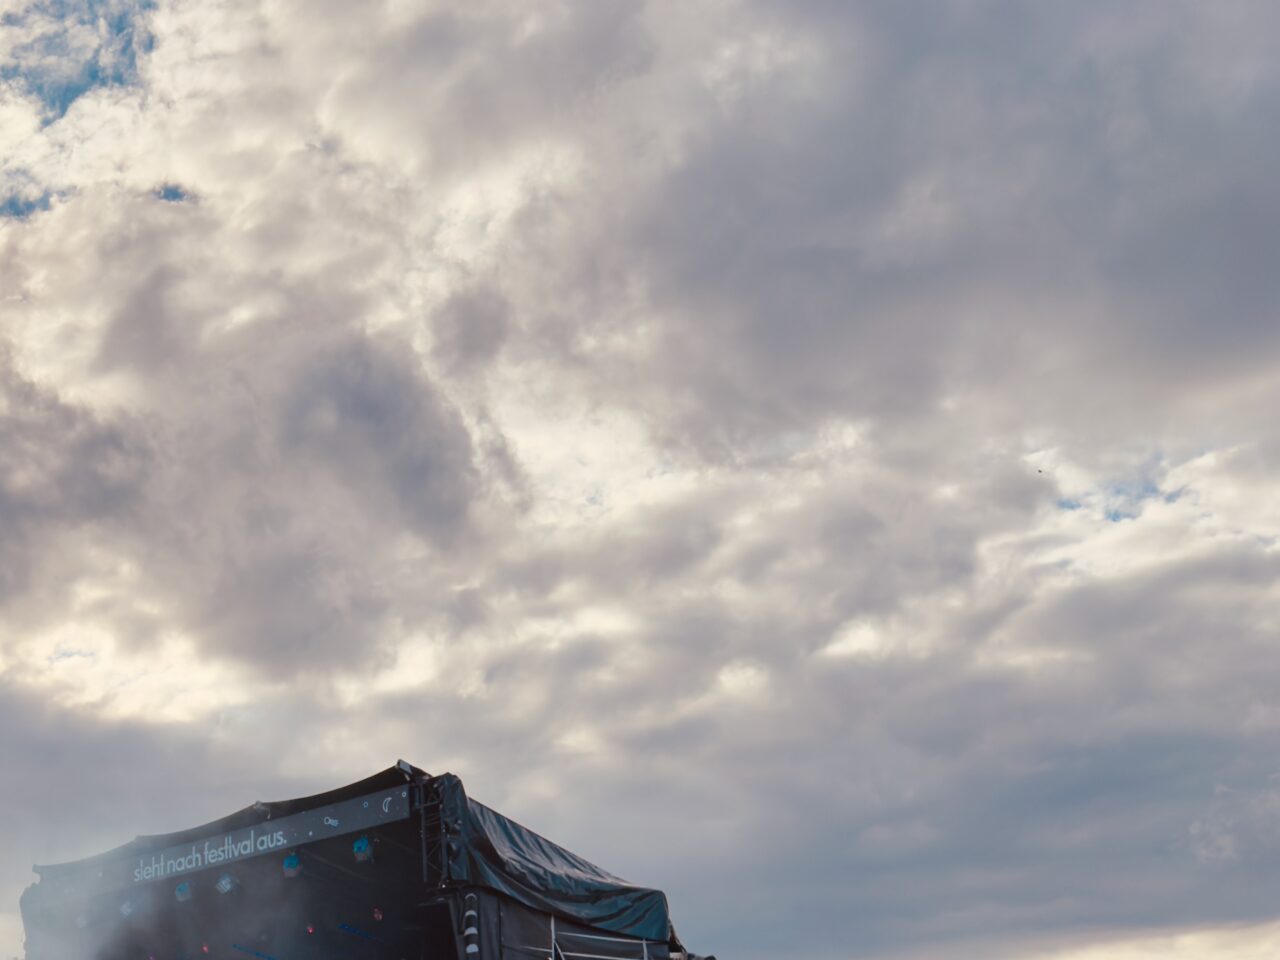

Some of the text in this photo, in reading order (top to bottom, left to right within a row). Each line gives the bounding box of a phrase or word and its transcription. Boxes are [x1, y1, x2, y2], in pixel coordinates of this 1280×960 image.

[133, 829, 288, 882] sieht nach festival aus.
